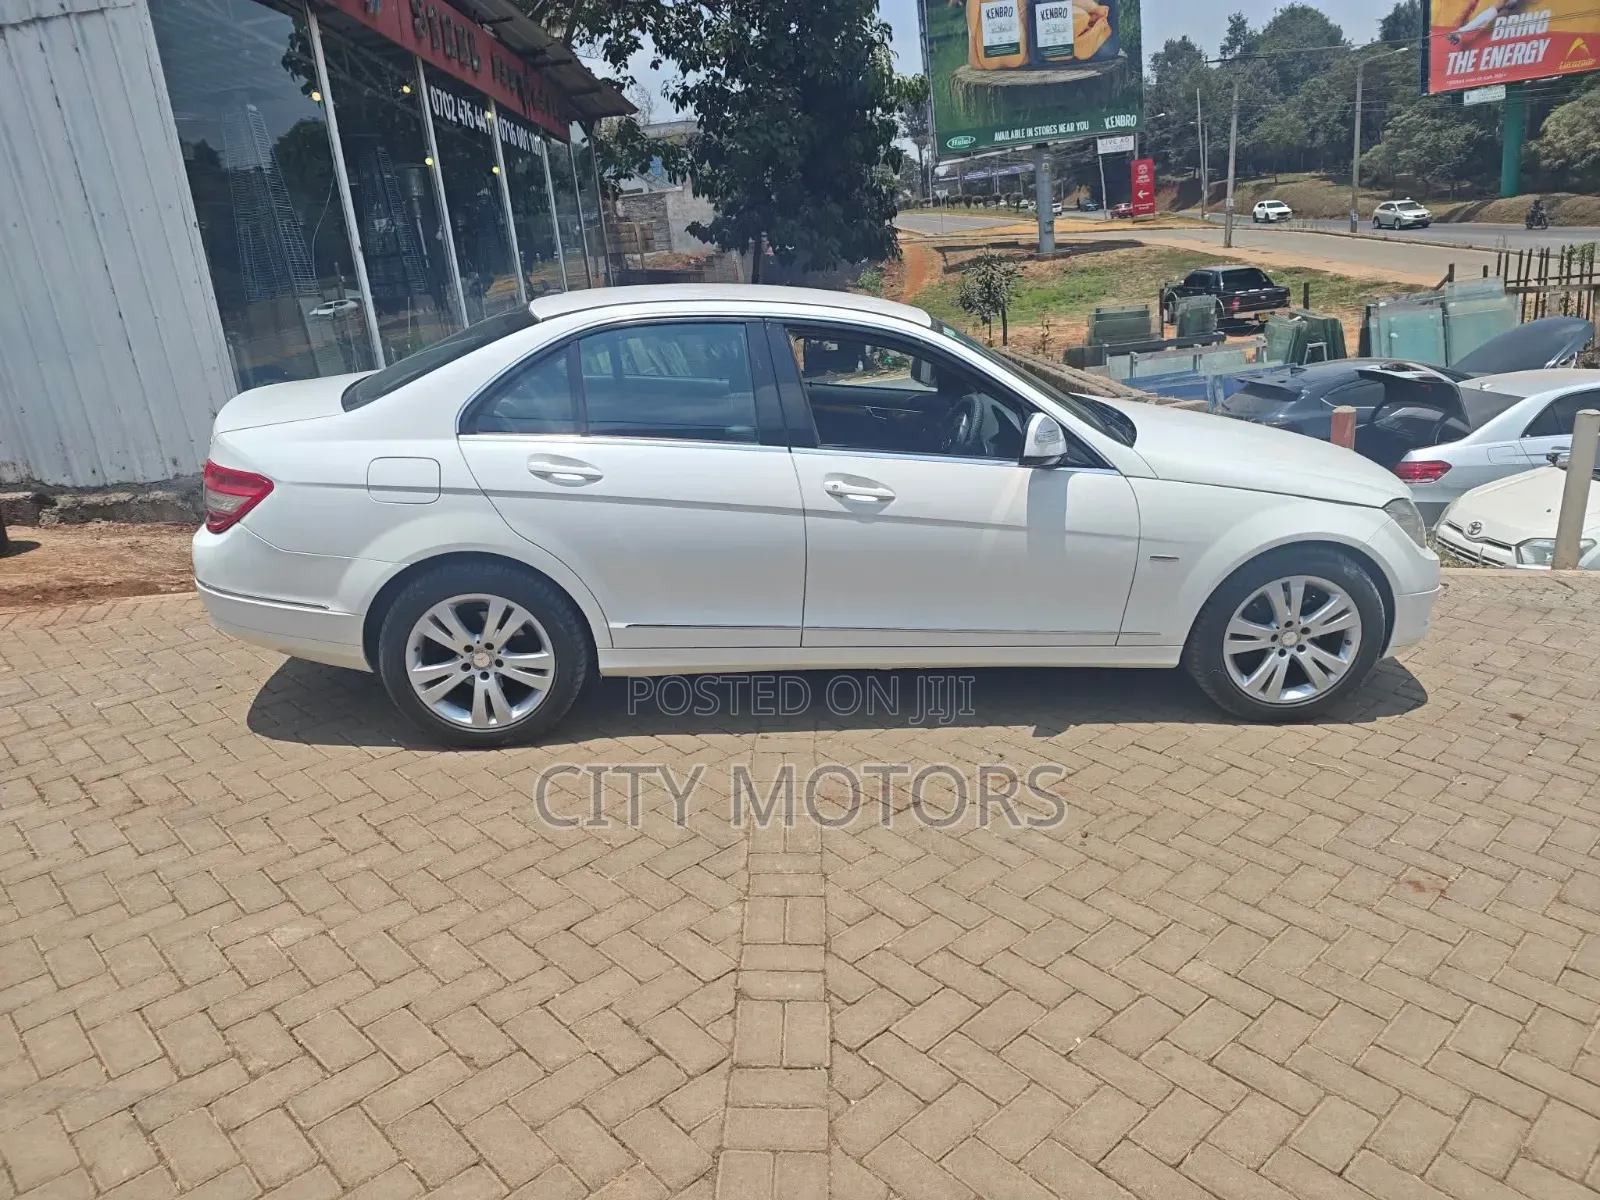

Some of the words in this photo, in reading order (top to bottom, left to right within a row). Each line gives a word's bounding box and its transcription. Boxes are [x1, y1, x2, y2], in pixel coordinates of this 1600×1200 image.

[985, 6, 1013, 20] KENBRO
[1040, 7, 1067, 21] KENBRO
[1491, 9, 1551, 41] BRING
[1446, 49, 1479, 75] THE
[1479, 37, 1551, 71] ENERGY
[430, 85, 457, 122] 0702
[457, 97, 474, 129] 476
[994, 128, 1025, 141] AVAILABLE
[1026, 127, 1033, 137] IN
[1034, 124, 1057, 136] STORES
[1058, 122, 1075, 133] NEAR
[1076, 120, 1089, 131] YOU
[1104, 114, 1137, 129] KENBRO
